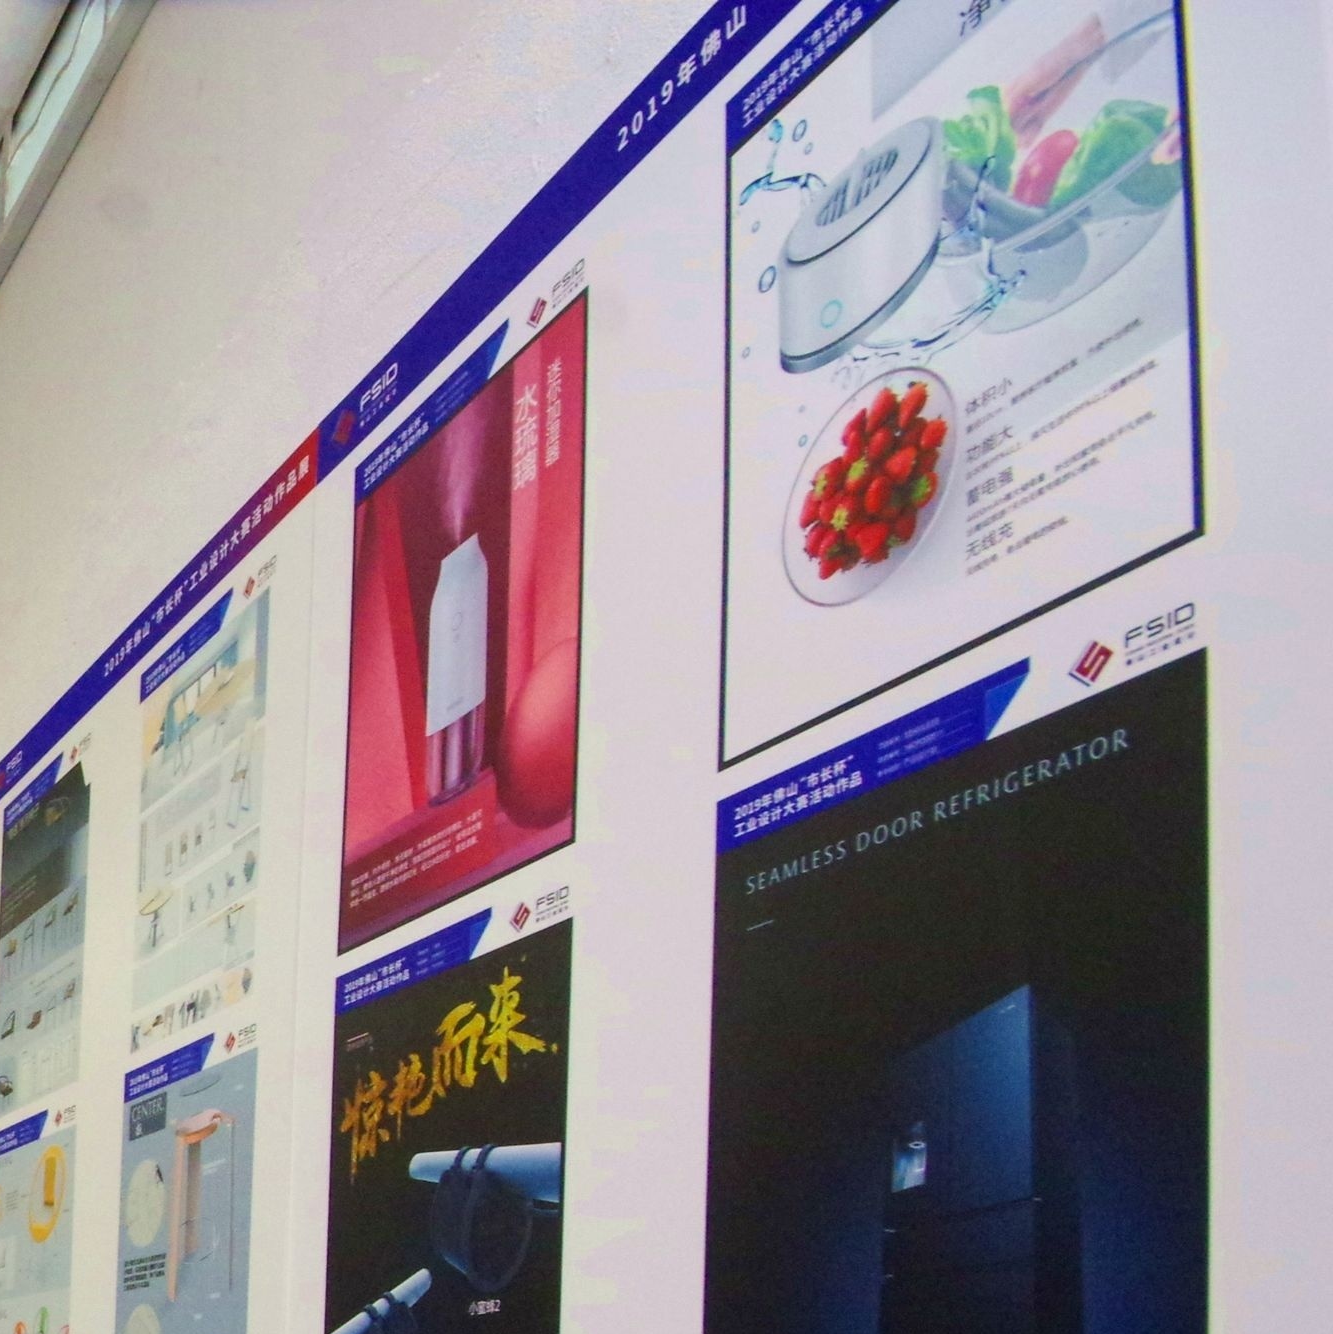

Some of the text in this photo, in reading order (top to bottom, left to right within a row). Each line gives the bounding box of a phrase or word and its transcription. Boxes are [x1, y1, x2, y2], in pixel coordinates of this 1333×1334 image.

[359, 362, 399, 411] FSID
[1124, 602, 1195, 648] FSID
[746, 840, 847, 895] SEAMLESS
[856, 811, 924, 853] DOOR
[934, 728, 1129, 822] REFRIGERATOR
[535, 886, 569, 911] FSID
